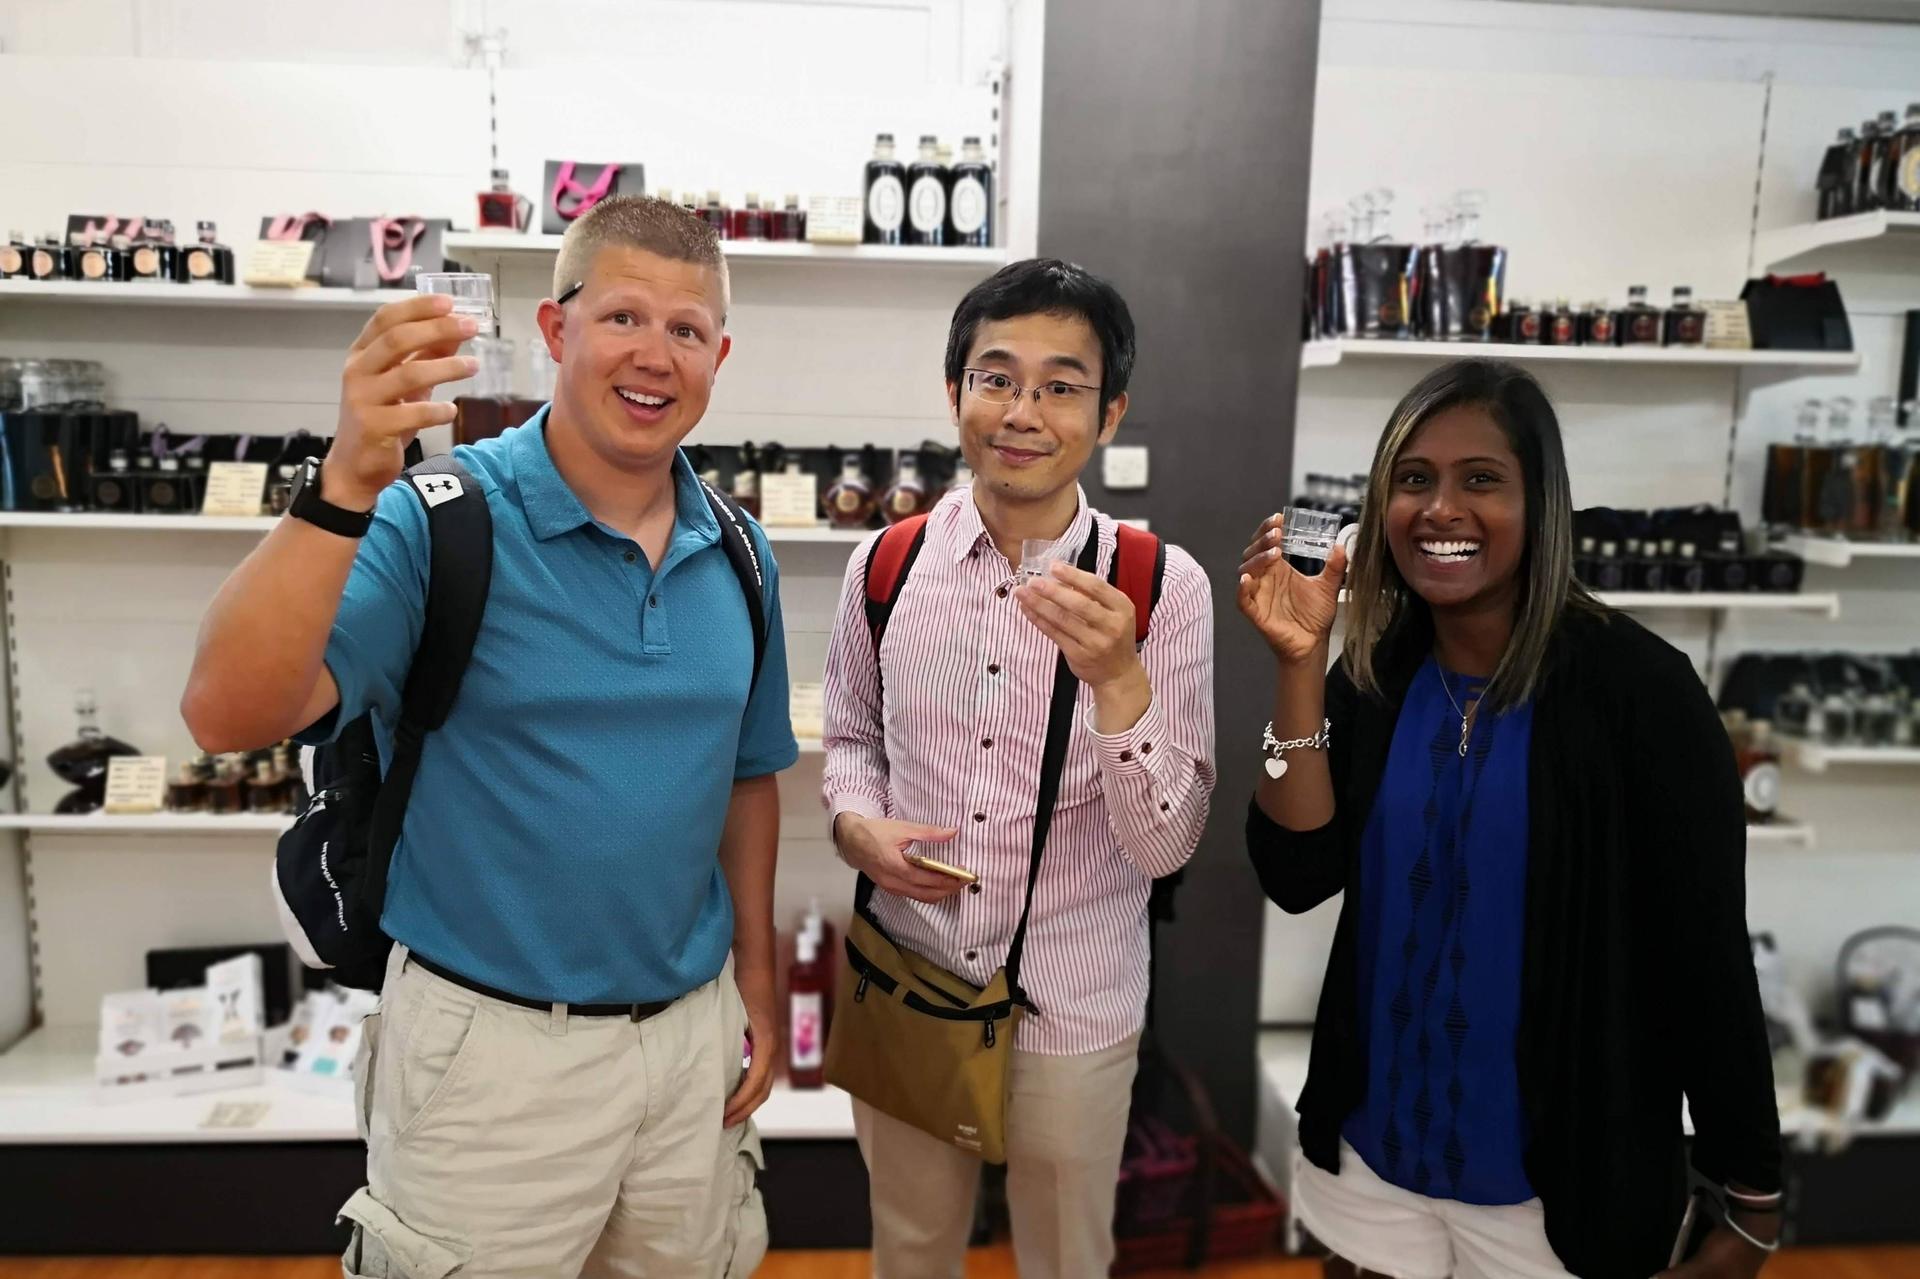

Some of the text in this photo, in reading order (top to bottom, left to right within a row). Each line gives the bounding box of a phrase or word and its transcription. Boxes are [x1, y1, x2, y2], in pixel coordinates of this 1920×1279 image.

[701, 481, 762, 586] UNDER ARMOUR
[320, 841, 349, 932] UNDER ARMOUR
